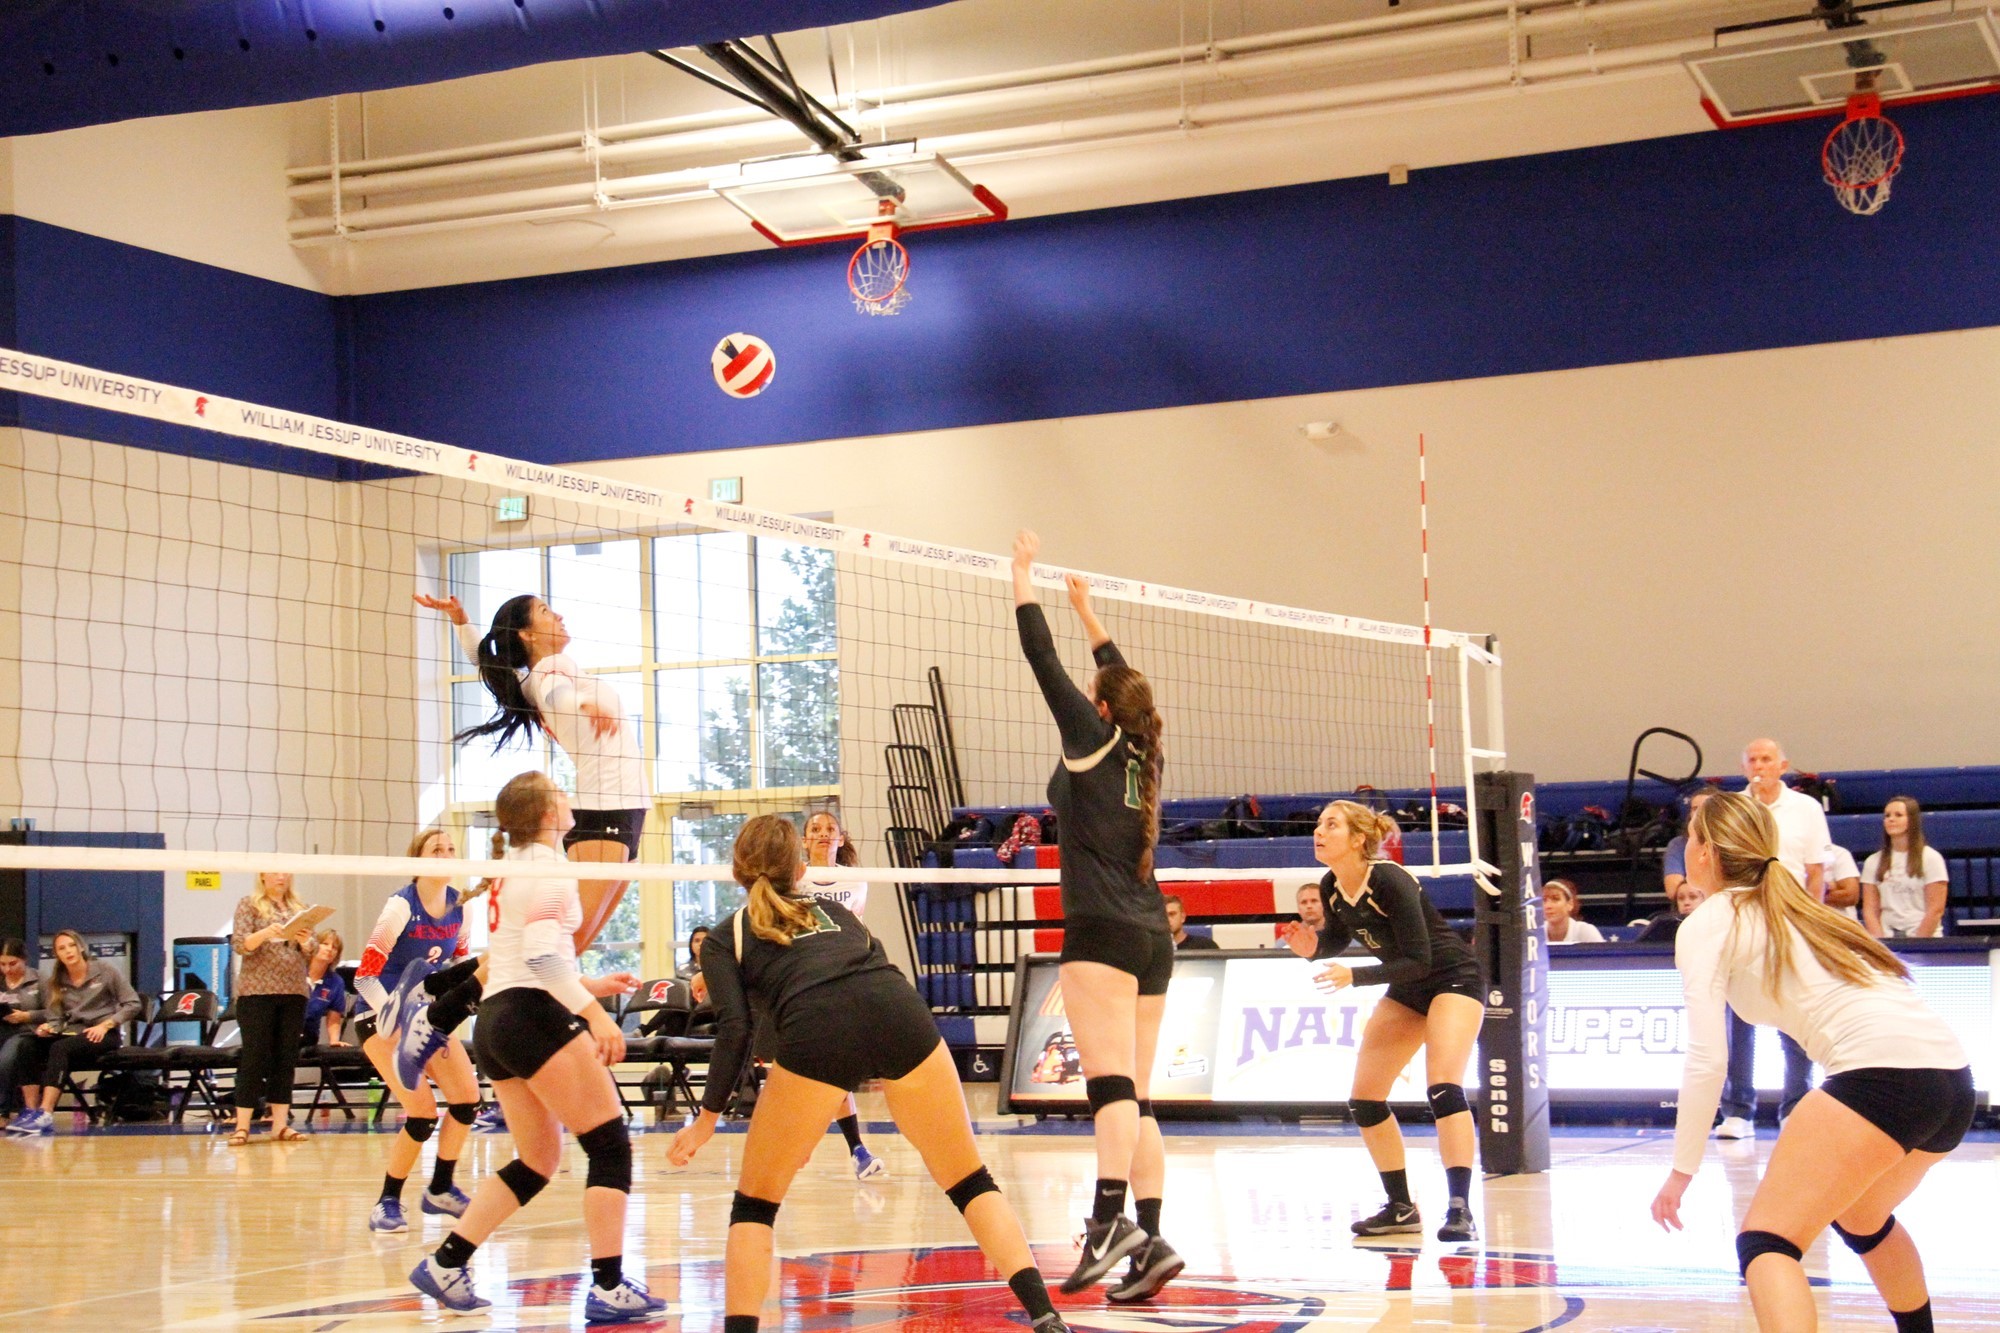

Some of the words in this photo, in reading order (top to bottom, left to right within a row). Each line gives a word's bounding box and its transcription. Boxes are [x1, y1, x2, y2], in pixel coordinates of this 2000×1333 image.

[60, 369, 162, 404] UNIVERSITY
[241, 408, 304, 436] WILLIAM
[308, 420, 361, 447] JESSUP
[365, 433, 441, 462] UNIVERSITY
[505, 463, 554, 485] WILLIAM
[556, 474, 600, 494] JESSUP
[601, 481, 664, 507] UNIVERSITY
[715, 506, 755, 525] WILLIAM
[756, 514, 792, 534] JESSUP
[793, 520, 846, 542] UNIVERSITY
[888, 539, 923, 557] WILLIAM
[1520, 842, 1540, 1089] WARRIORS
[1236, 1006, 1358, 1067] NAI
